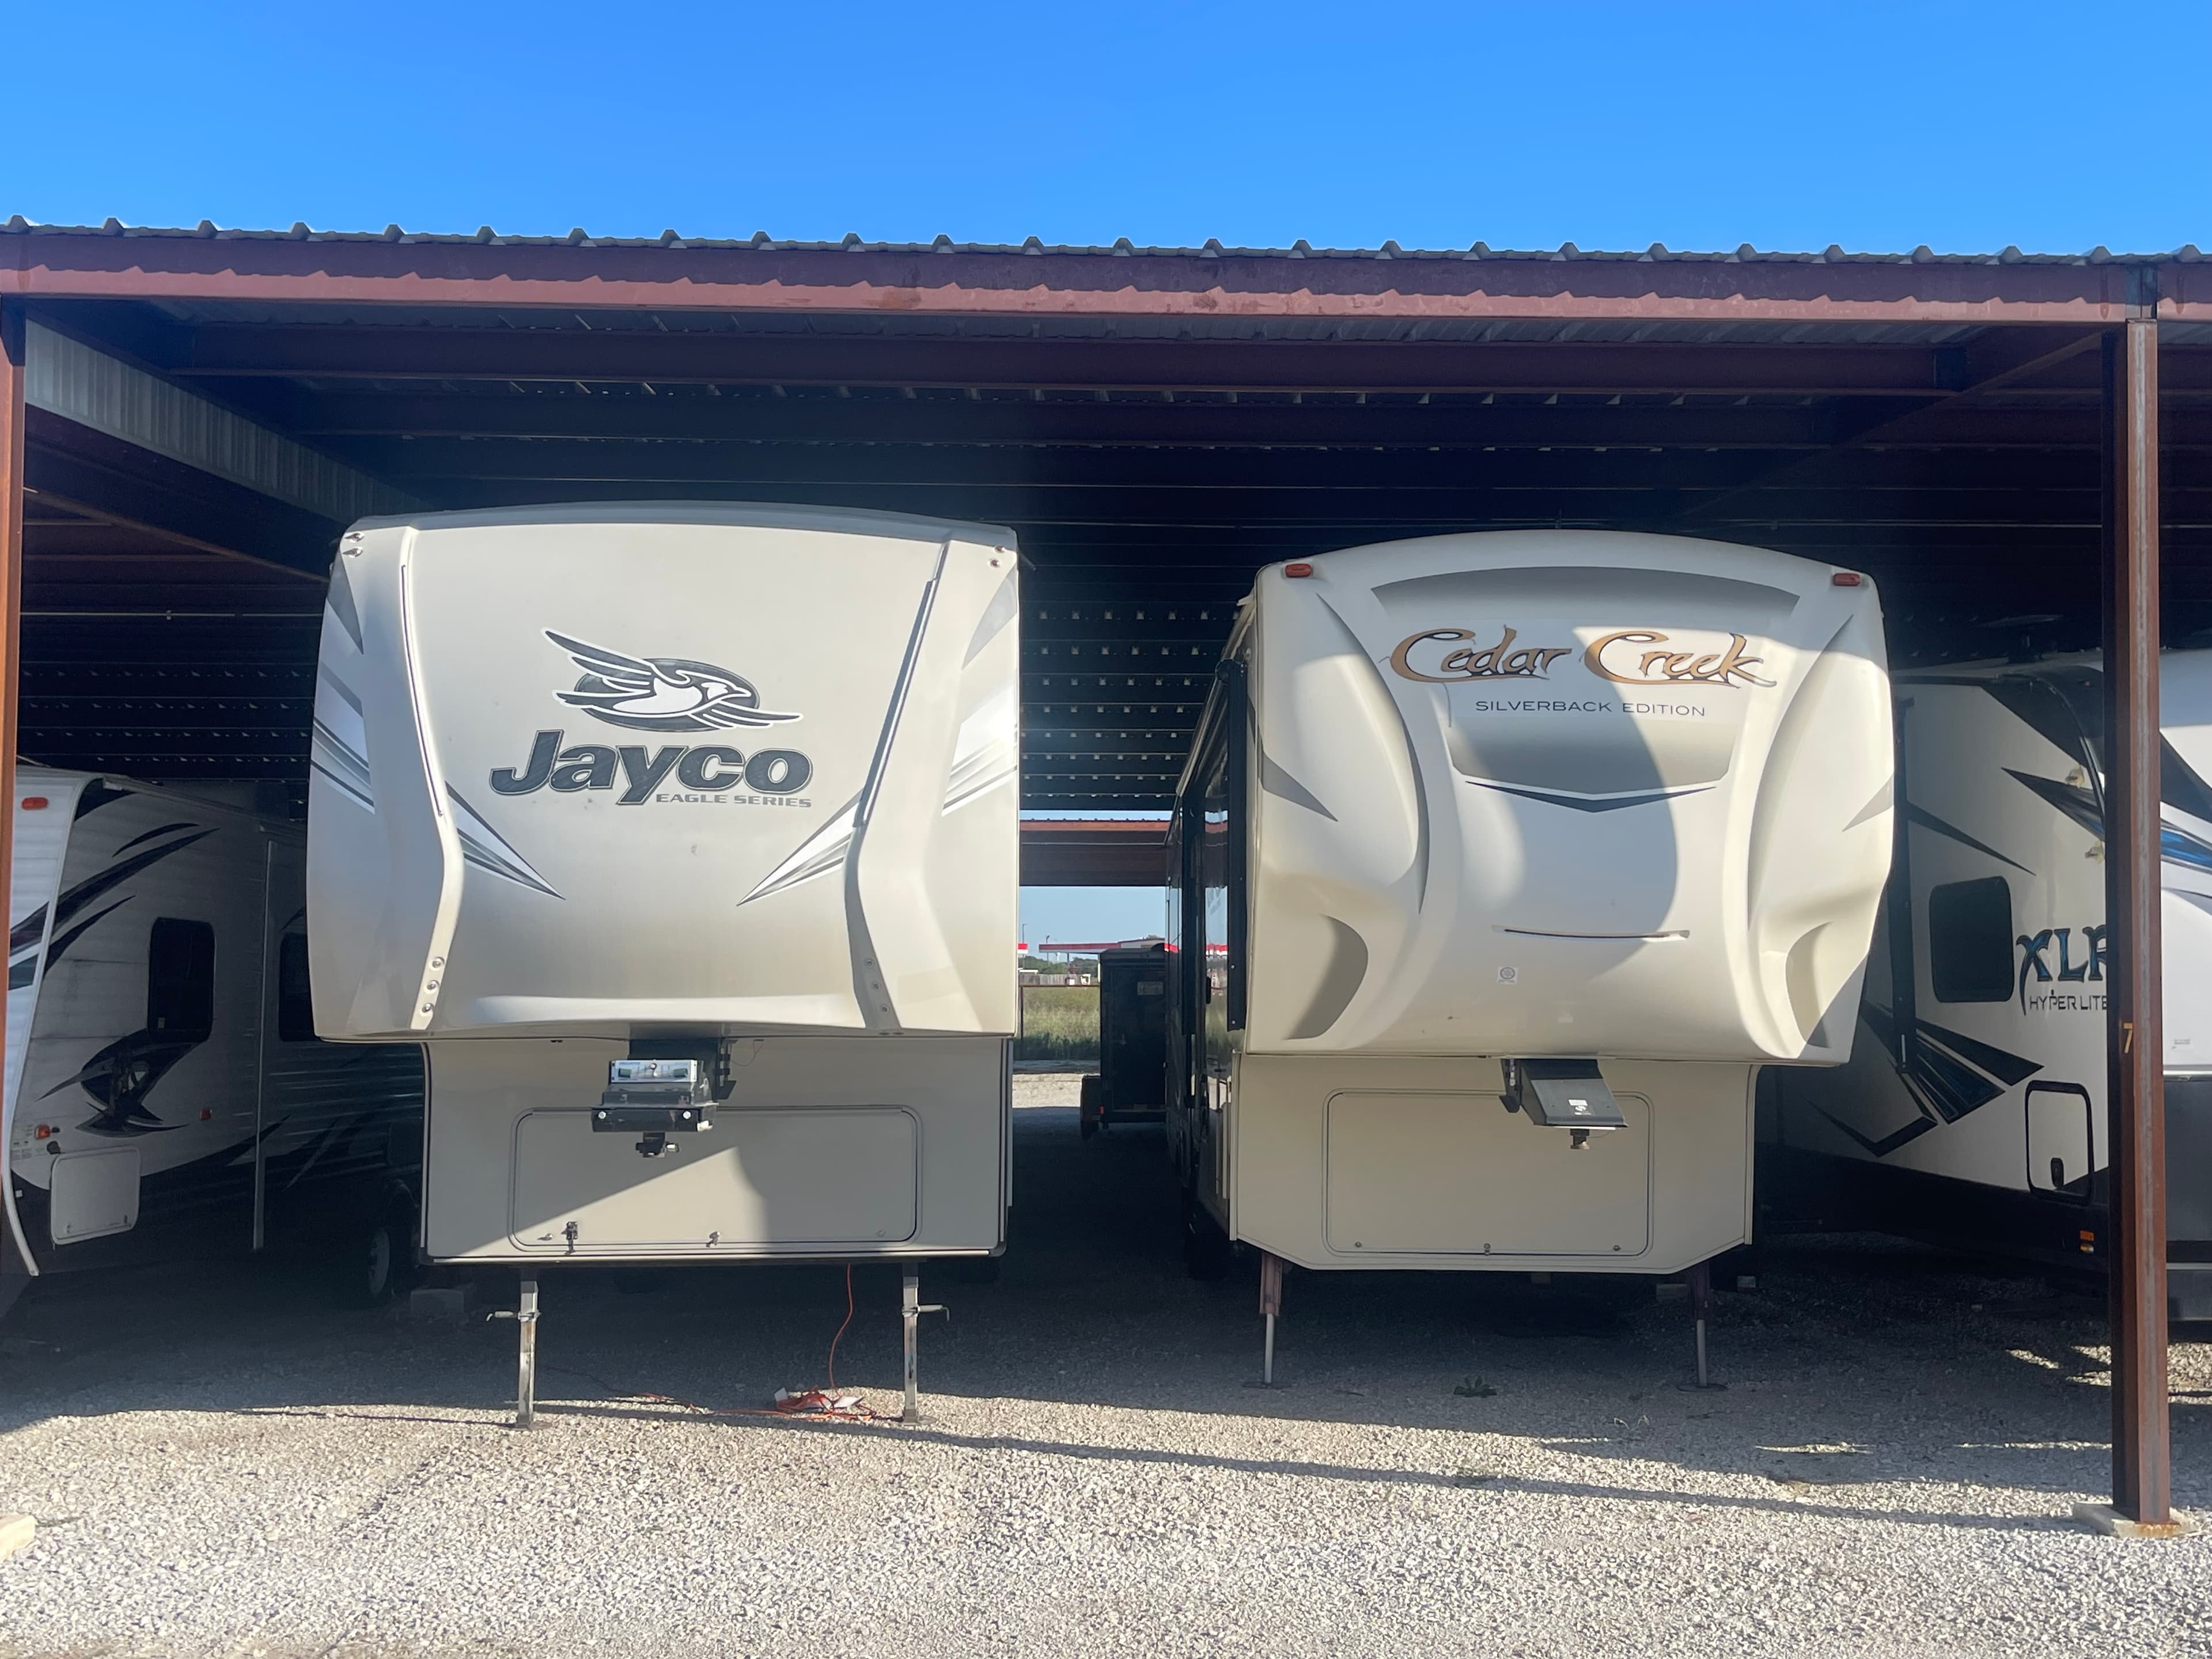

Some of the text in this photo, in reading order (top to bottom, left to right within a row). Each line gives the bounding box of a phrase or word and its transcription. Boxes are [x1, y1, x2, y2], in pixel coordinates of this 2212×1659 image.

[1380, 624, 1777, 689] Cedar Creek
[1475, 700, 1706, 717] SILVERBACK EDITION
[489, 729, 813, 806] Jayco
[656, 793, 812, 808] EAGLE SERIES
[2122, 1022, 2133, 1054] 7
